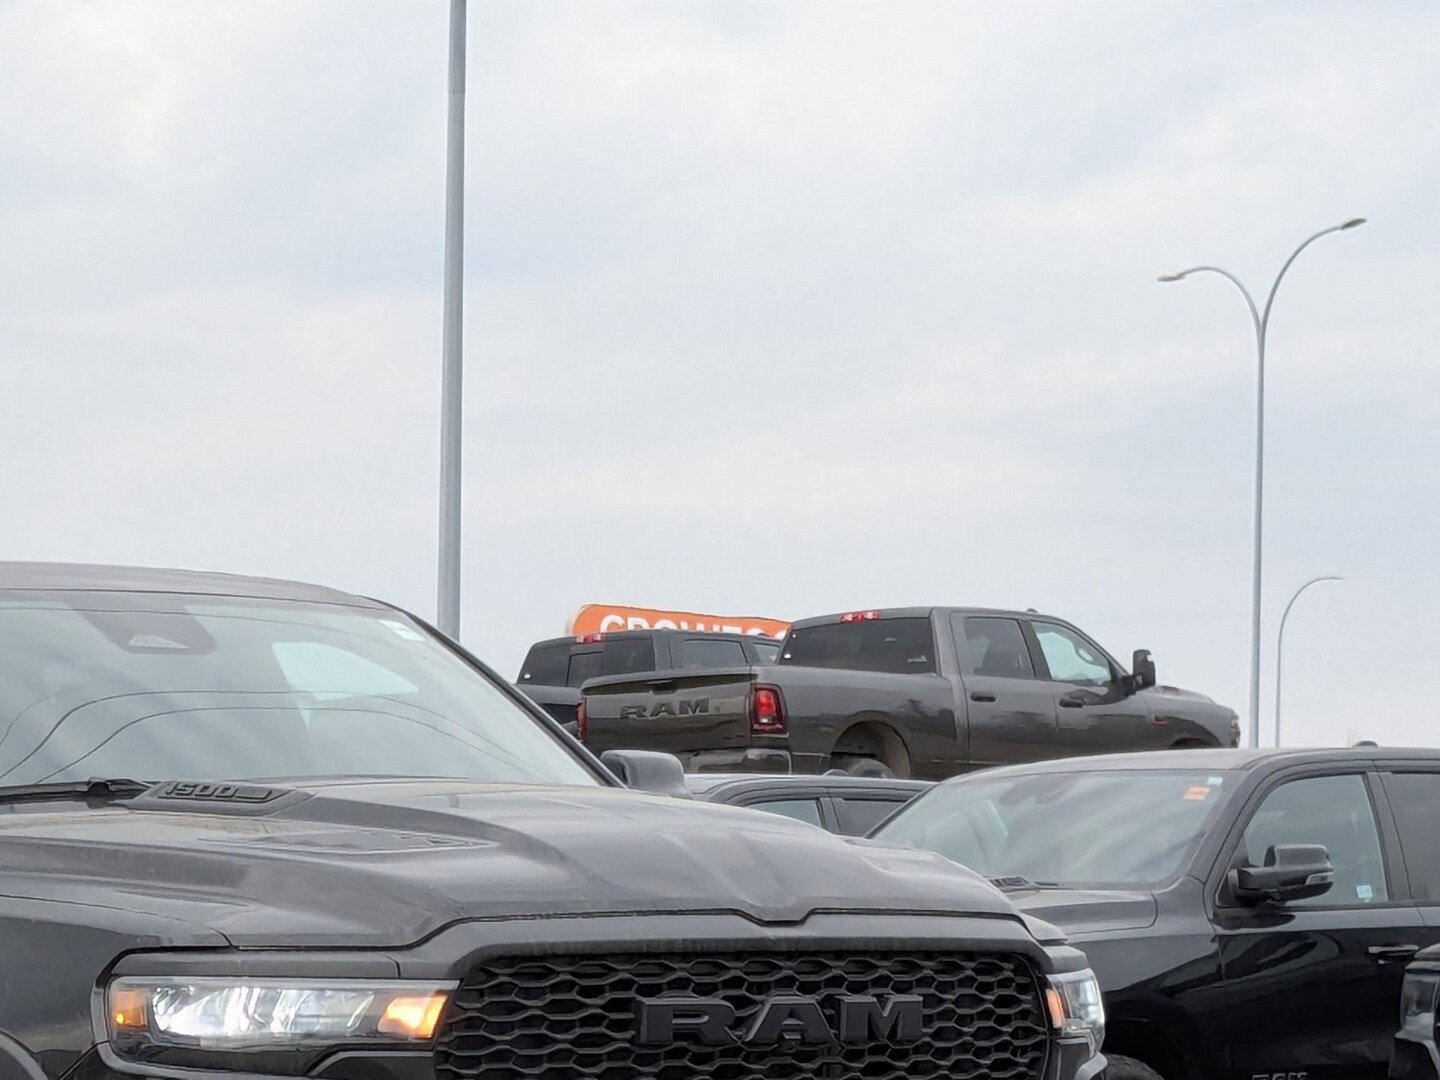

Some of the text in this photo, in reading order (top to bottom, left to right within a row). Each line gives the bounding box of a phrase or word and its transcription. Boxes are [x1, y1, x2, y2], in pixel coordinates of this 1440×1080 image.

[619, 699, 710, 720] RAM
[164, 781, 242, 798] 1500
[637, 994, 924, 1045] RAM
